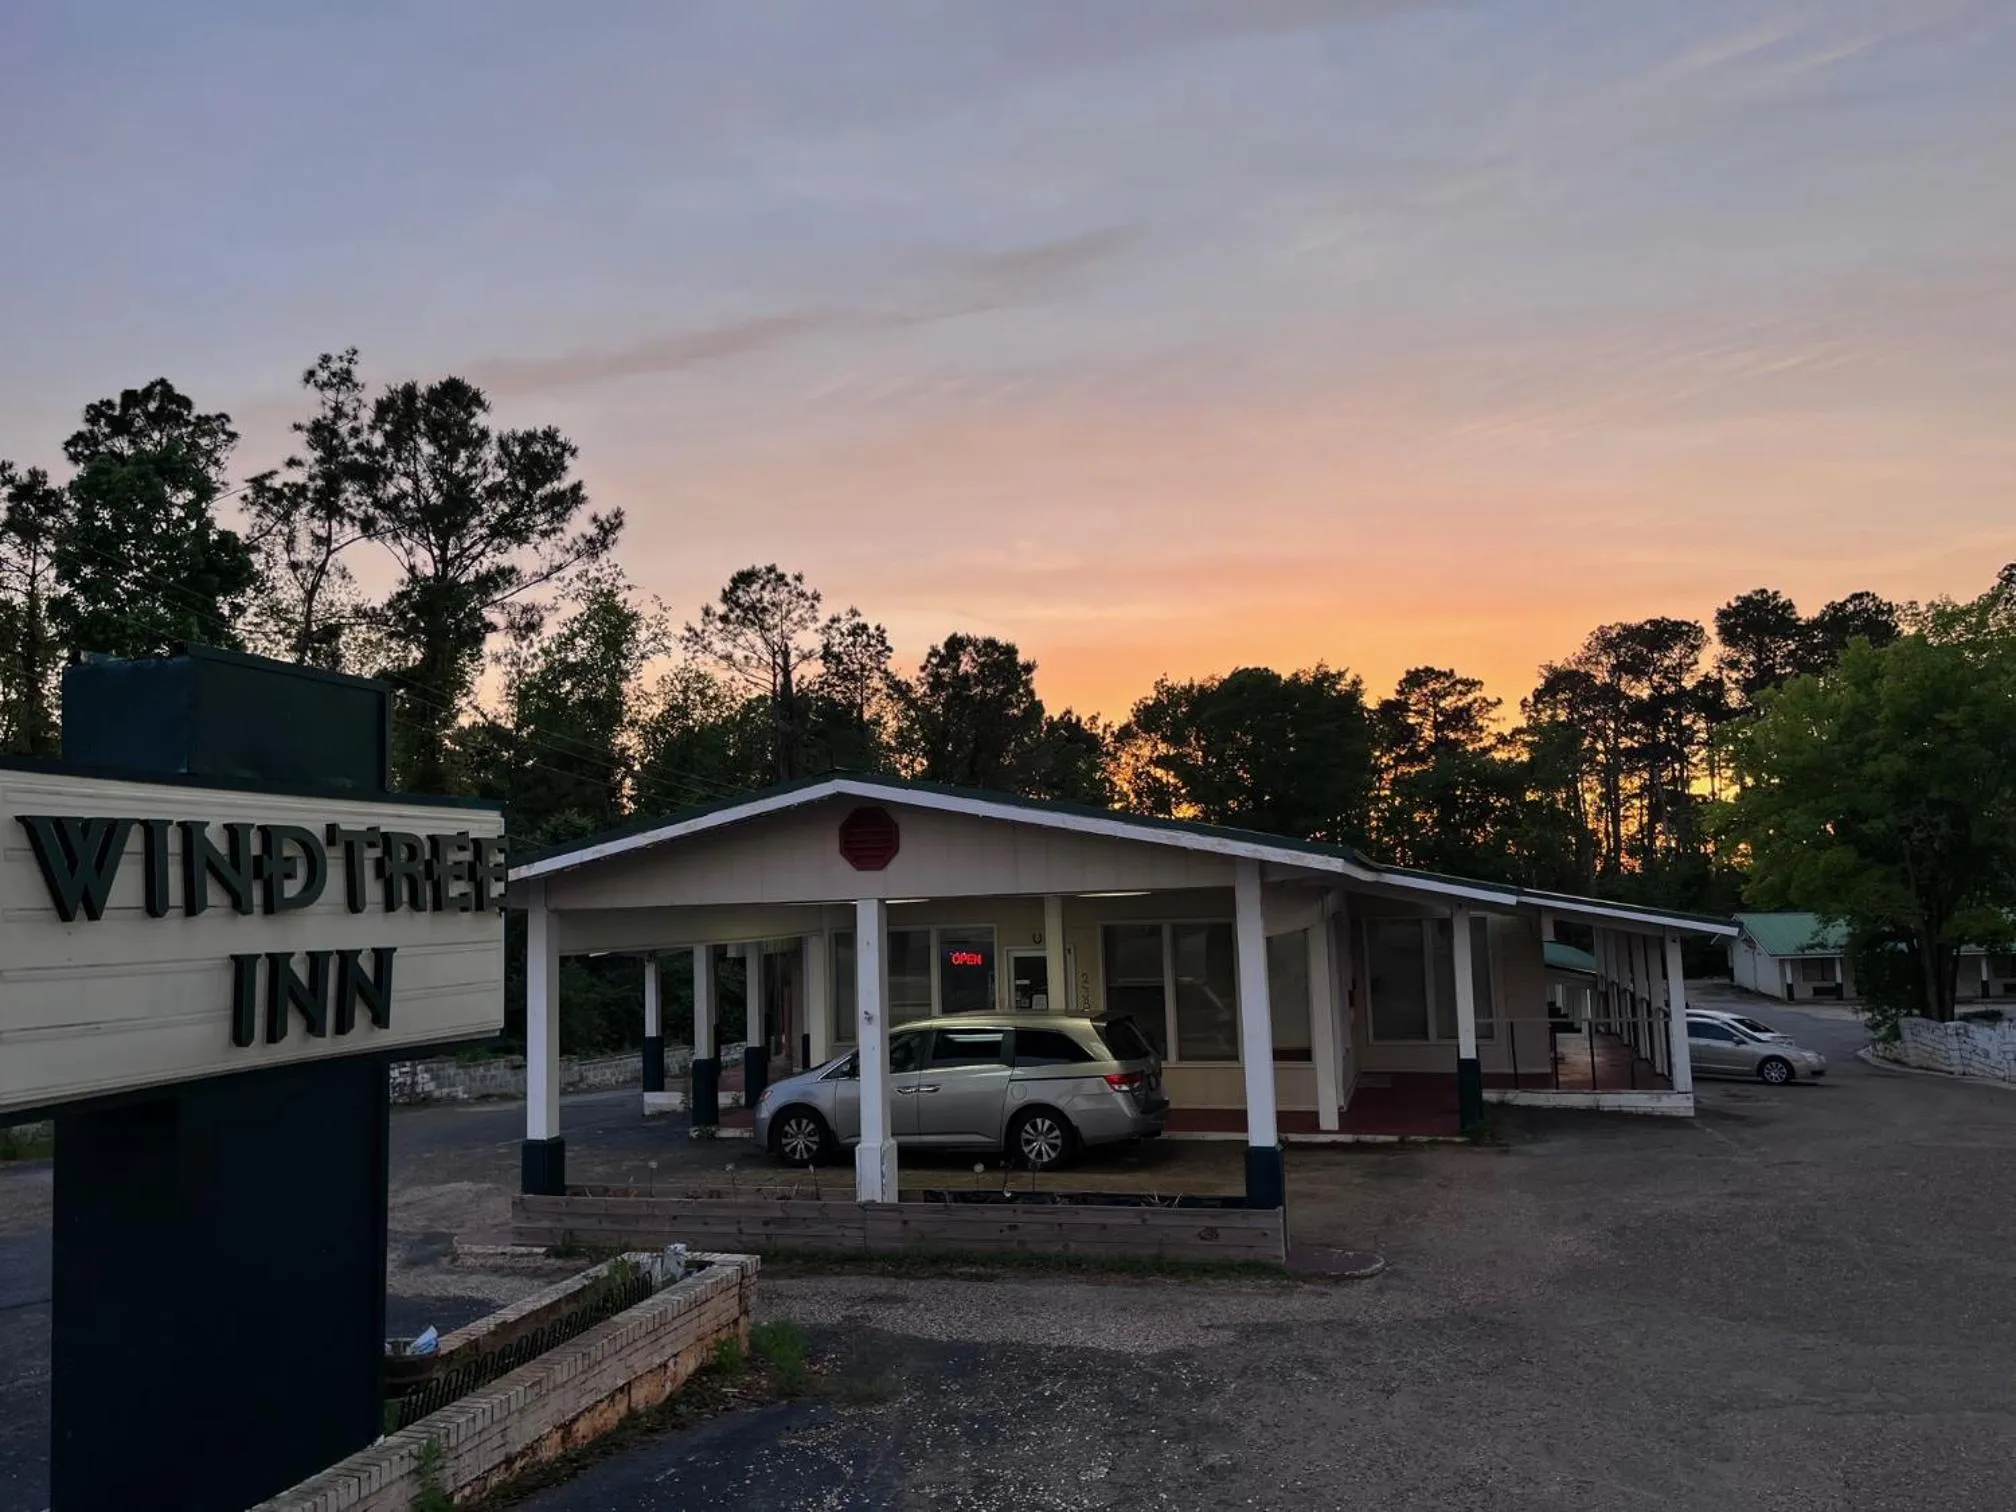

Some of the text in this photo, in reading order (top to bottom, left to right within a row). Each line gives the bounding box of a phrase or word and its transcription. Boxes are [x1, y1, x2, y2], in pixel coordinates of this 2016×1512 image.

[15, 815, 508, 922] WINDTREE
[230, 947, 397, 1047] INN
[951, 952, 982, 965] OPEN
